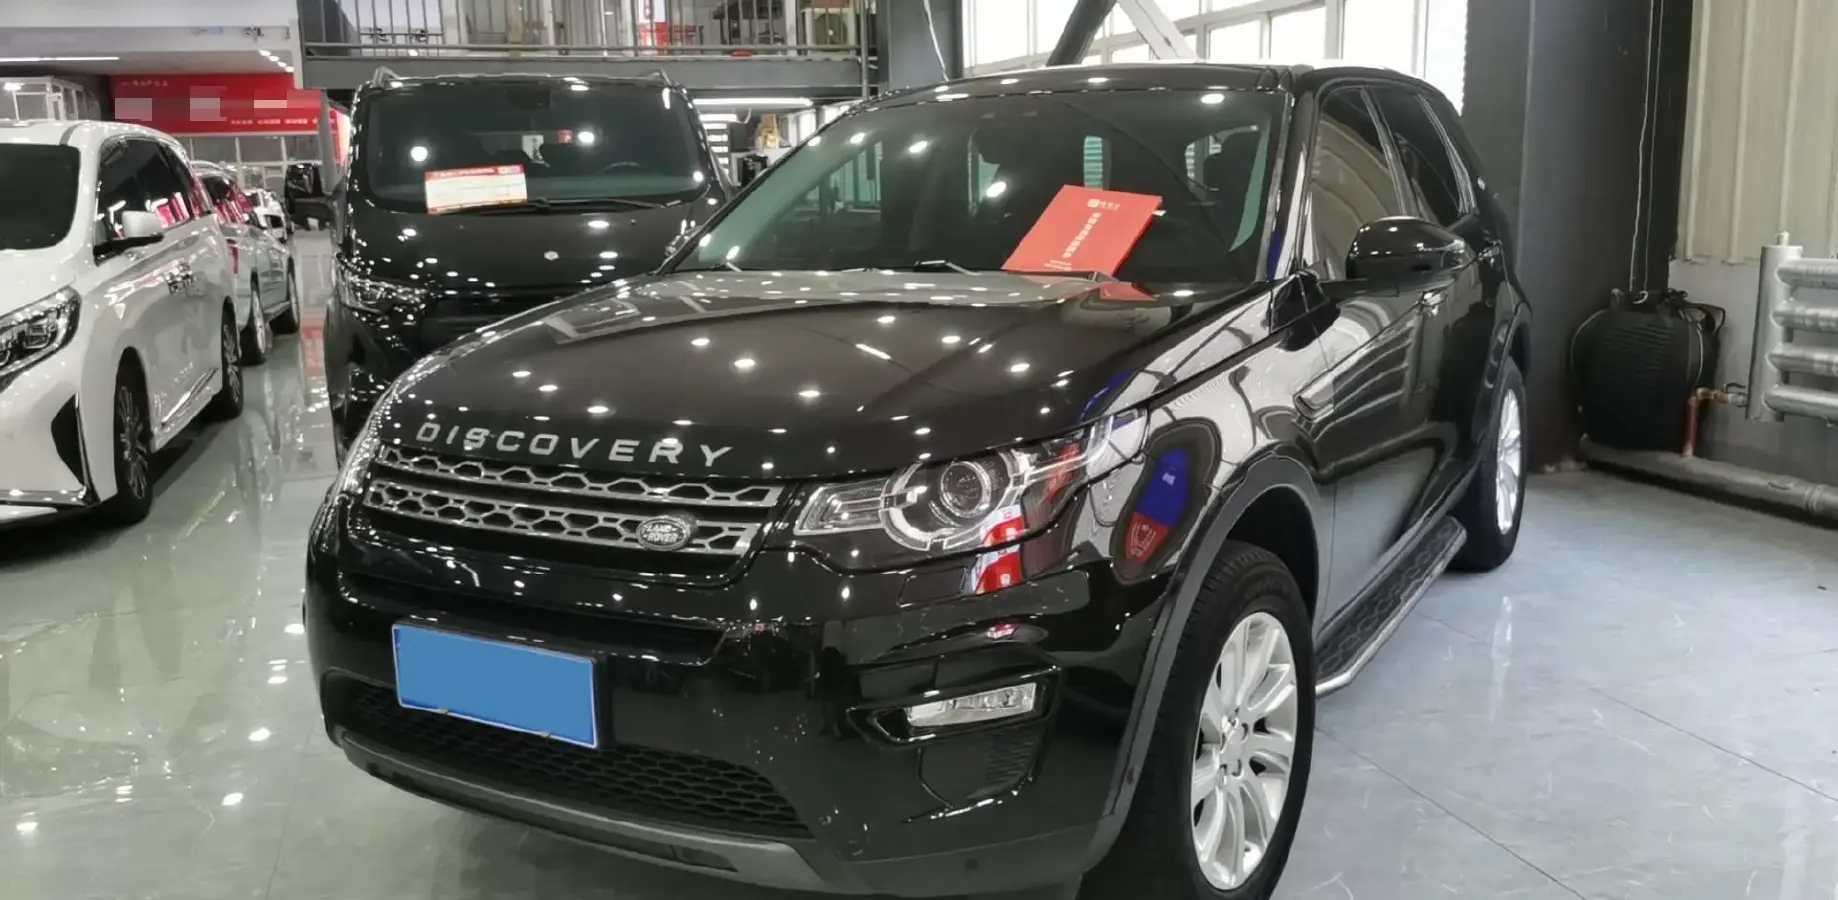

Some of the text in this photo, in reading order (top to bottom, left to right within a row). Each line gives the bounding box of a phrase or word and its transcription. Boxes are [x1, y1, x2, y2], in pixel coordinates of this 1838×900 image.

[416, 422, 732, 467] DISCOVERY
[646, 523, 672, 533] LAND
[646, 532, 678, 543] ROVER
